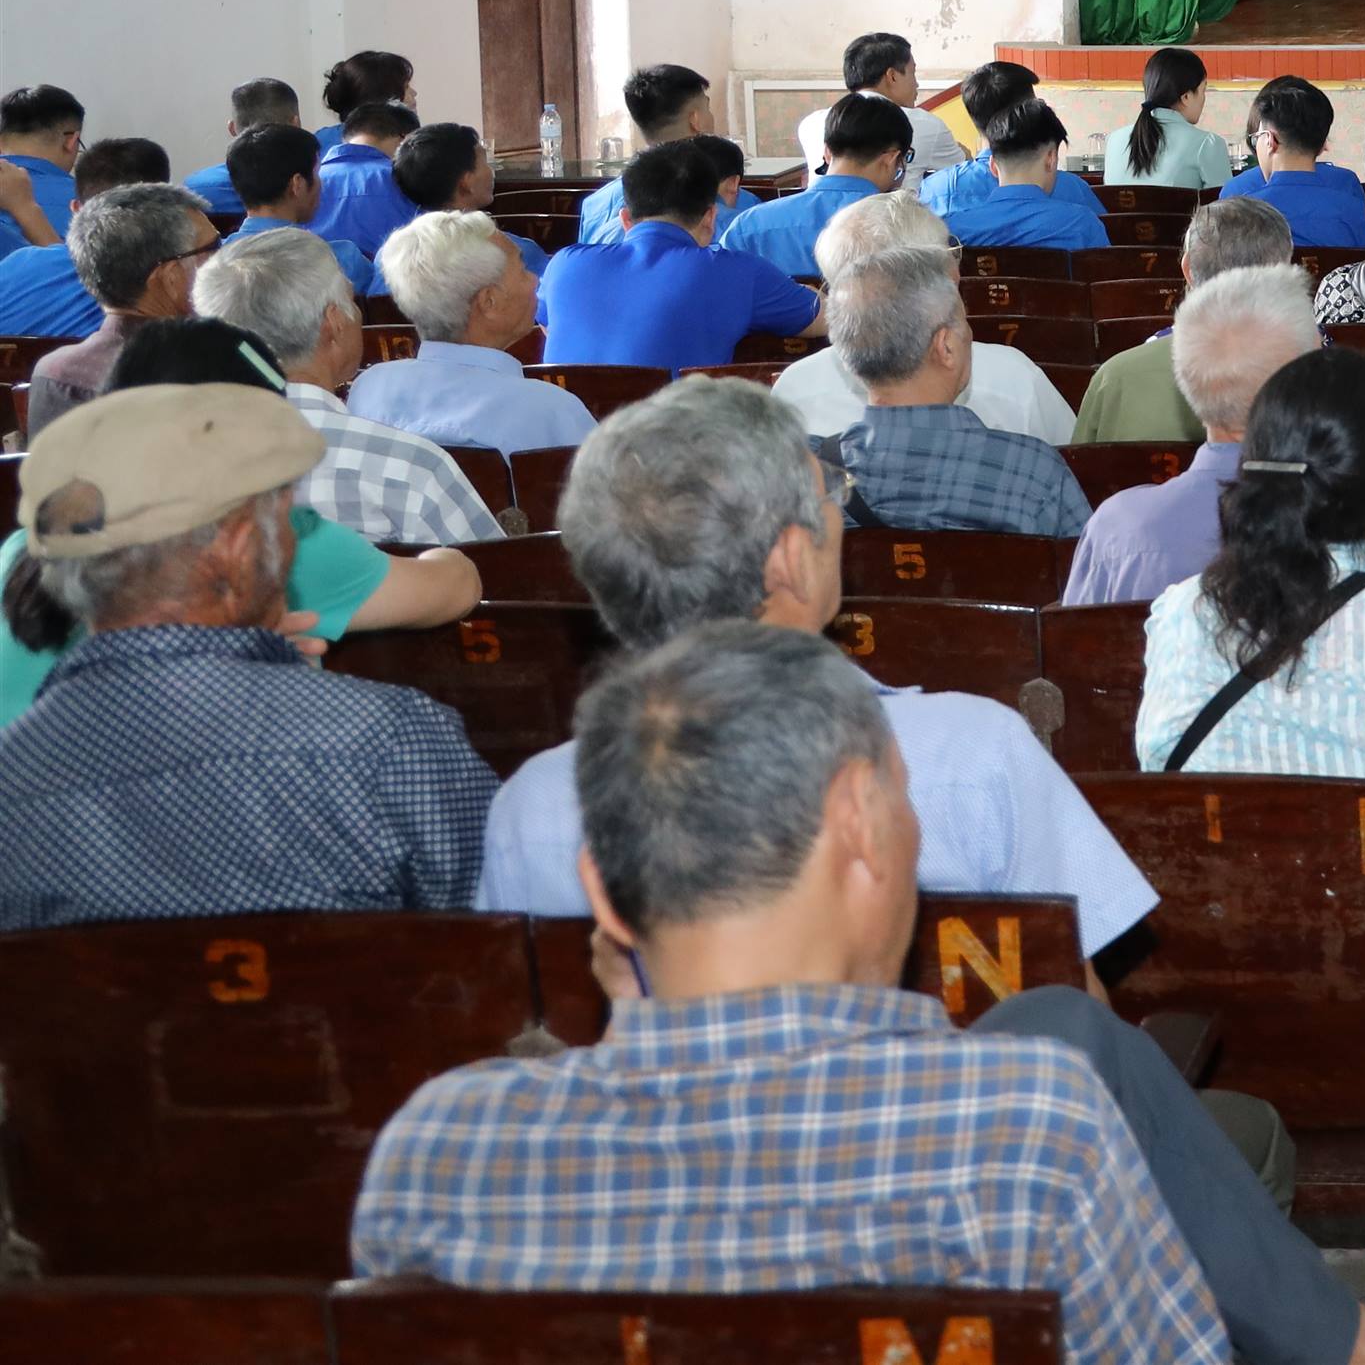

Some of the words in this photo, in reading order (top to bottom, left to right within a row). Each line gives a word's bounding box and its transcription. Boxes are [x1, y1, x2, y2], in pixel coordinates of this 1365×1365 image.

[893, 543, 926, 580] 5
[463, 620, 501, 663] 5
[835, 612, 875, 656] 3
[205, 940, 270, 1002] 3
[938, 917, 1023, 1014] N
